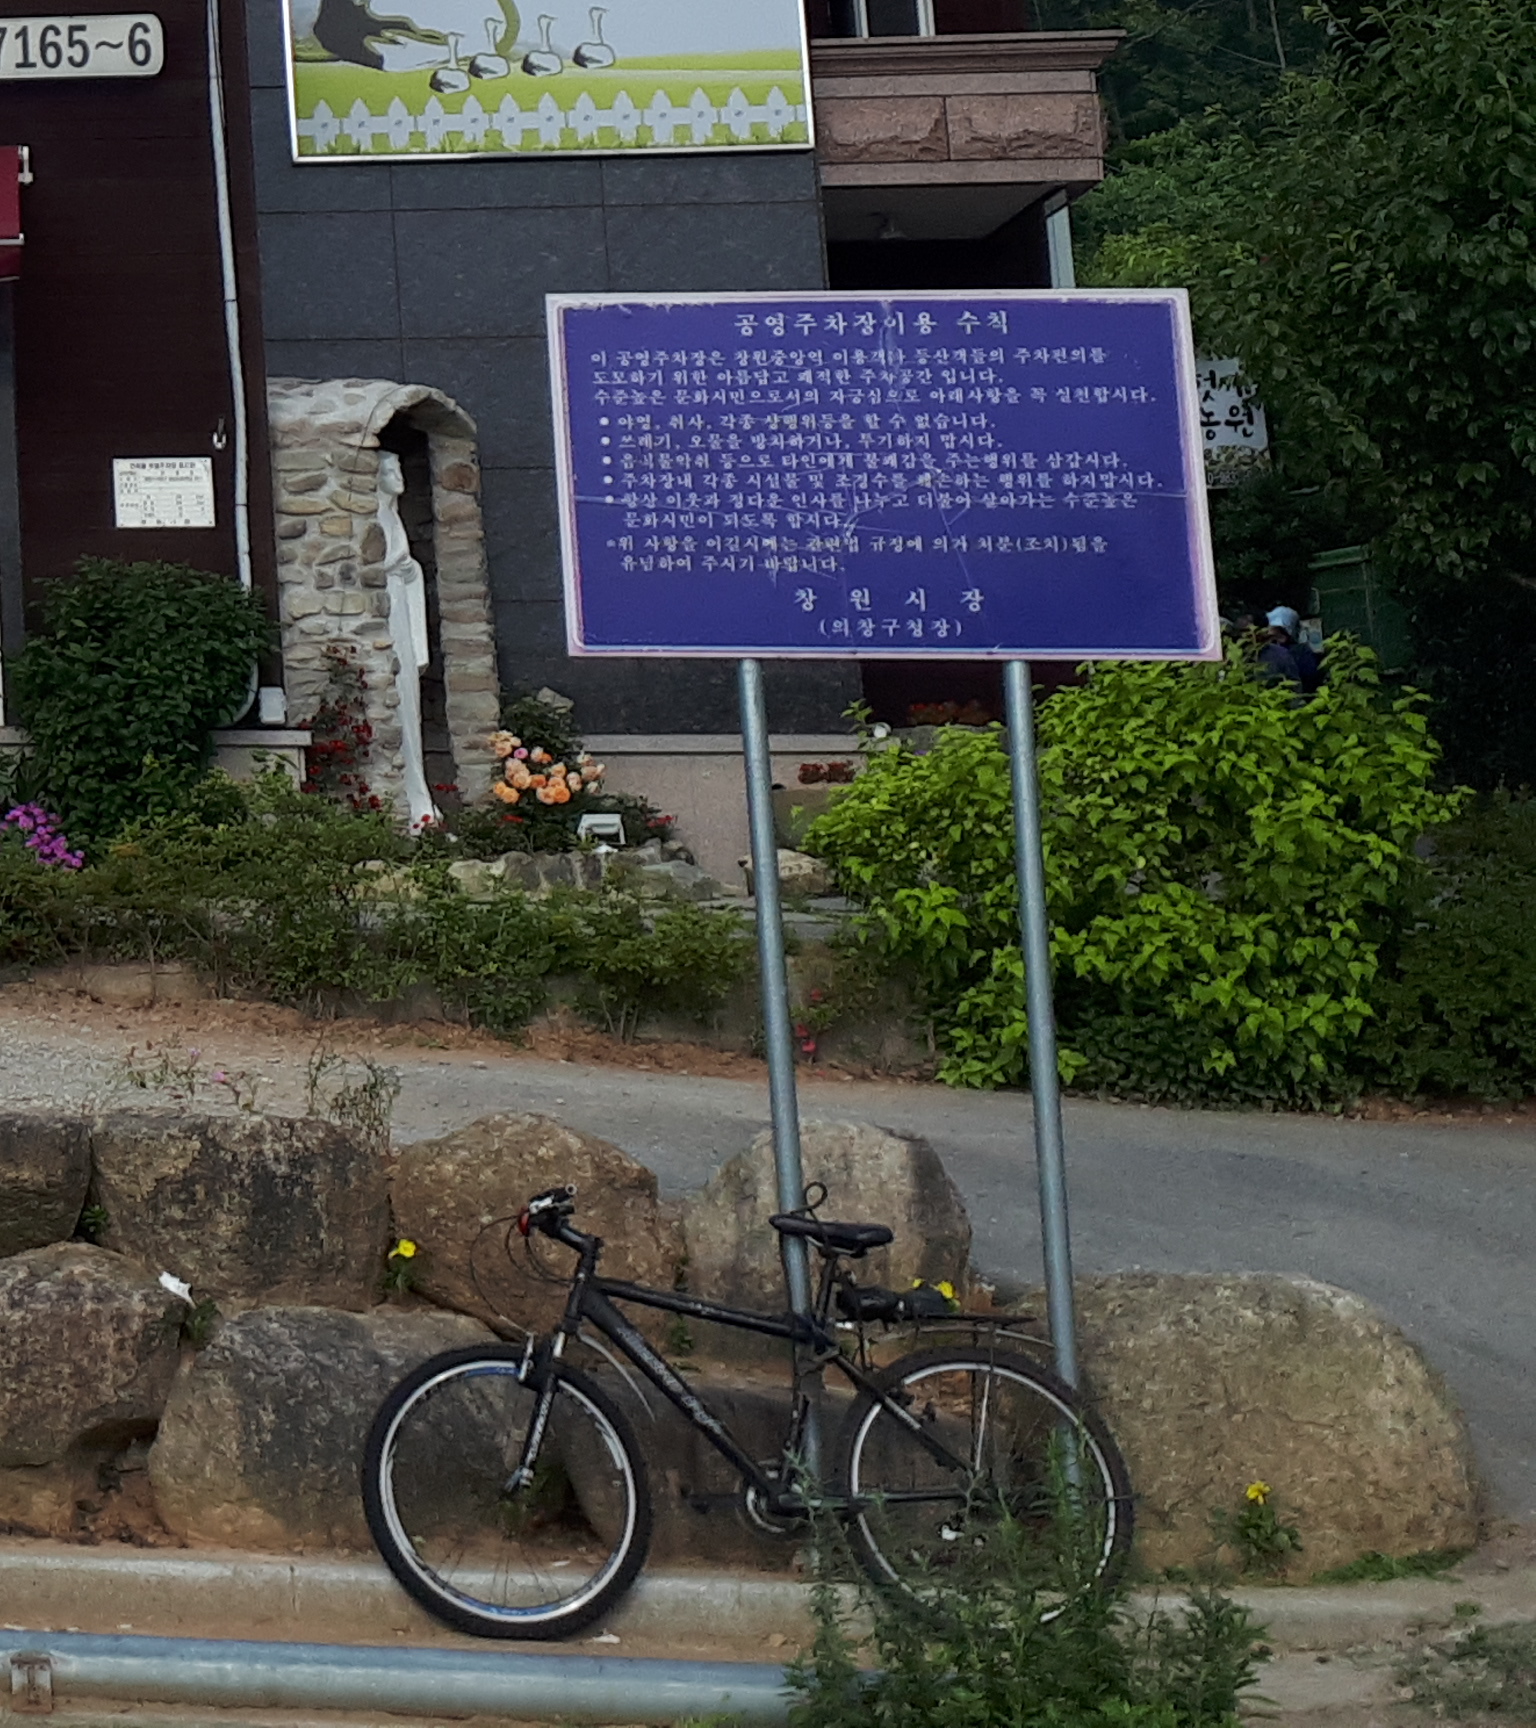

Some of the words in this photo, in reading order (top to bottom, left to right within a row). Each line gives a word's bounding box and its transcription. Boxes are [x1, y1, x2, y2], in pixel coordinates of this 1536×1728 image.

[735, 312, 936, 336] 공영주차장이용
[957, 311, 1007, 334] 수칙
[591, 351, 606, 366] 이
[617, 351, 724, 366] 공영주차장은
[735, 350, 823, 368] 창원중앙역
[916, 348, 1004, 365] 등산객들의
[1014, 348, 1106, 364] 주차편의를
[593, 370, 662, 385] 도모하기
[673, 370, 707, 385] 위한
[717, 370, 788, 385] 아름답고
[798, 369, 850, 384] 쾌적한
[860, 368, 932, 385] 주차공간
[941, 368, 1002, 384] 입니다.
[595, 389, 665, 405] 수준높은
[675, 389, 818, 405] 문화시민으로서의
[930, 388, 1020, 403] 아래사항을
[1031, 388, 1046, 403] 꼭
[1056, 387, 1155, 403] 실천합시다.
[721, 414, 754, 430] 각종
[763, 414, 854, 430] 상행위등을
[864, 414, 880, 429] 할
[889, 414, 906, 429] 수
[915, 413, 994, 429] 없습니다.
[689, 434, 741, 449] 오물을
[859, 433, 929, 448] 투기하지
[940, 433, 1002, 449] 맙시다.
[720, 454, 773, 469] 등으로
[782, 453, 853, 468] 타인에게
[1047, 452, 1126, 468] 삼갑시다.
[622, 473, 692, 489] 주차장내
[704, 473, 737, 489] 각종
[809, 473, 823, 488] 및
[836, 473, 906, 490] 조경수를
[999, 473, 1052, 488] 행위를
[622, 492, 657, 508] 항상
[666, 492, 719, 510] 이웃과
[730, 492, 782, 509] 정다운
[792, 492, 845, 508] 인사를
[983, 492, 1054, 508] 살아가는
[624, 512, 713, 528] 문화시민이
[724, 513, 776, 528] 되도록
[645, 536, 696, 552] 사항을
[871, 536, 922, 552] 규정에
[934, 536, 967, 552] 의거
[702, 555, 753, 571] 주시기
